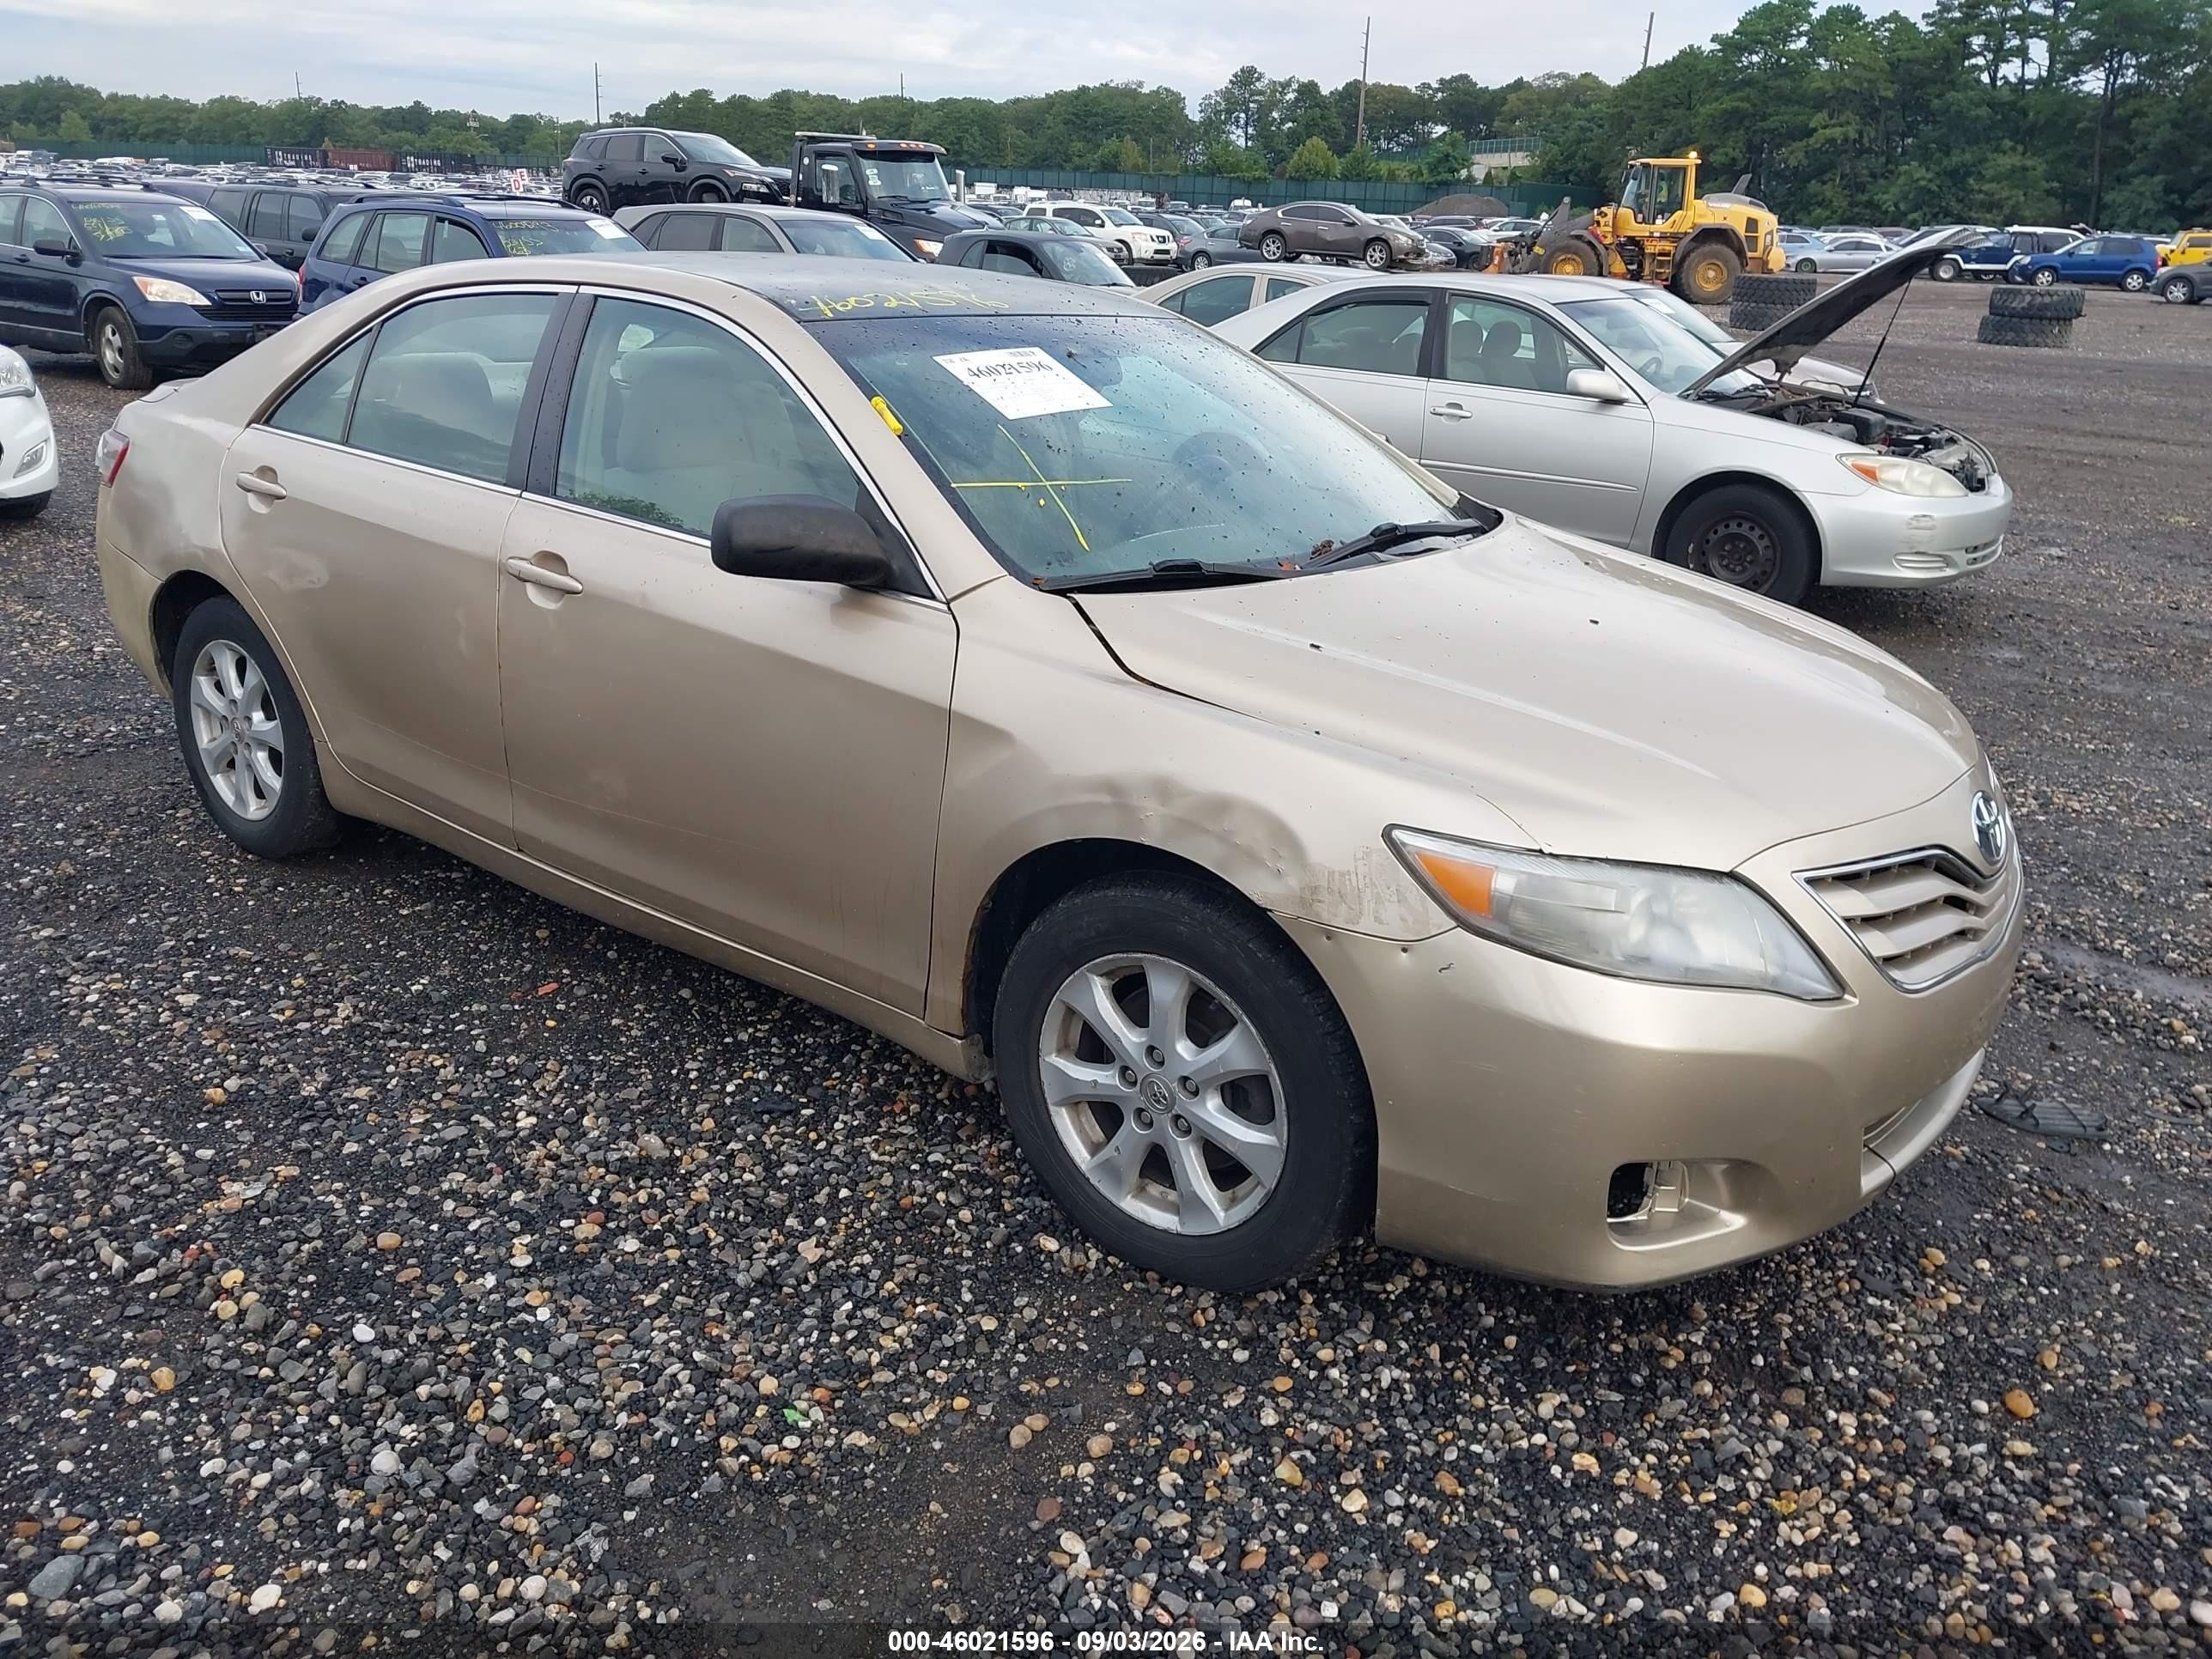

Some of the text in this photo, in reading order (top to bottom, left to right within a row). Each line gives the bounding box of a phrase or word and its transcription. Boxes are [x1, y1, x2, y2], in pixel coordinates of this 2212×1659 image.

[519, 171, 526, 180] E
[513, 179, 520, 191] D
[967, 361, 1054, 378] 46021596
